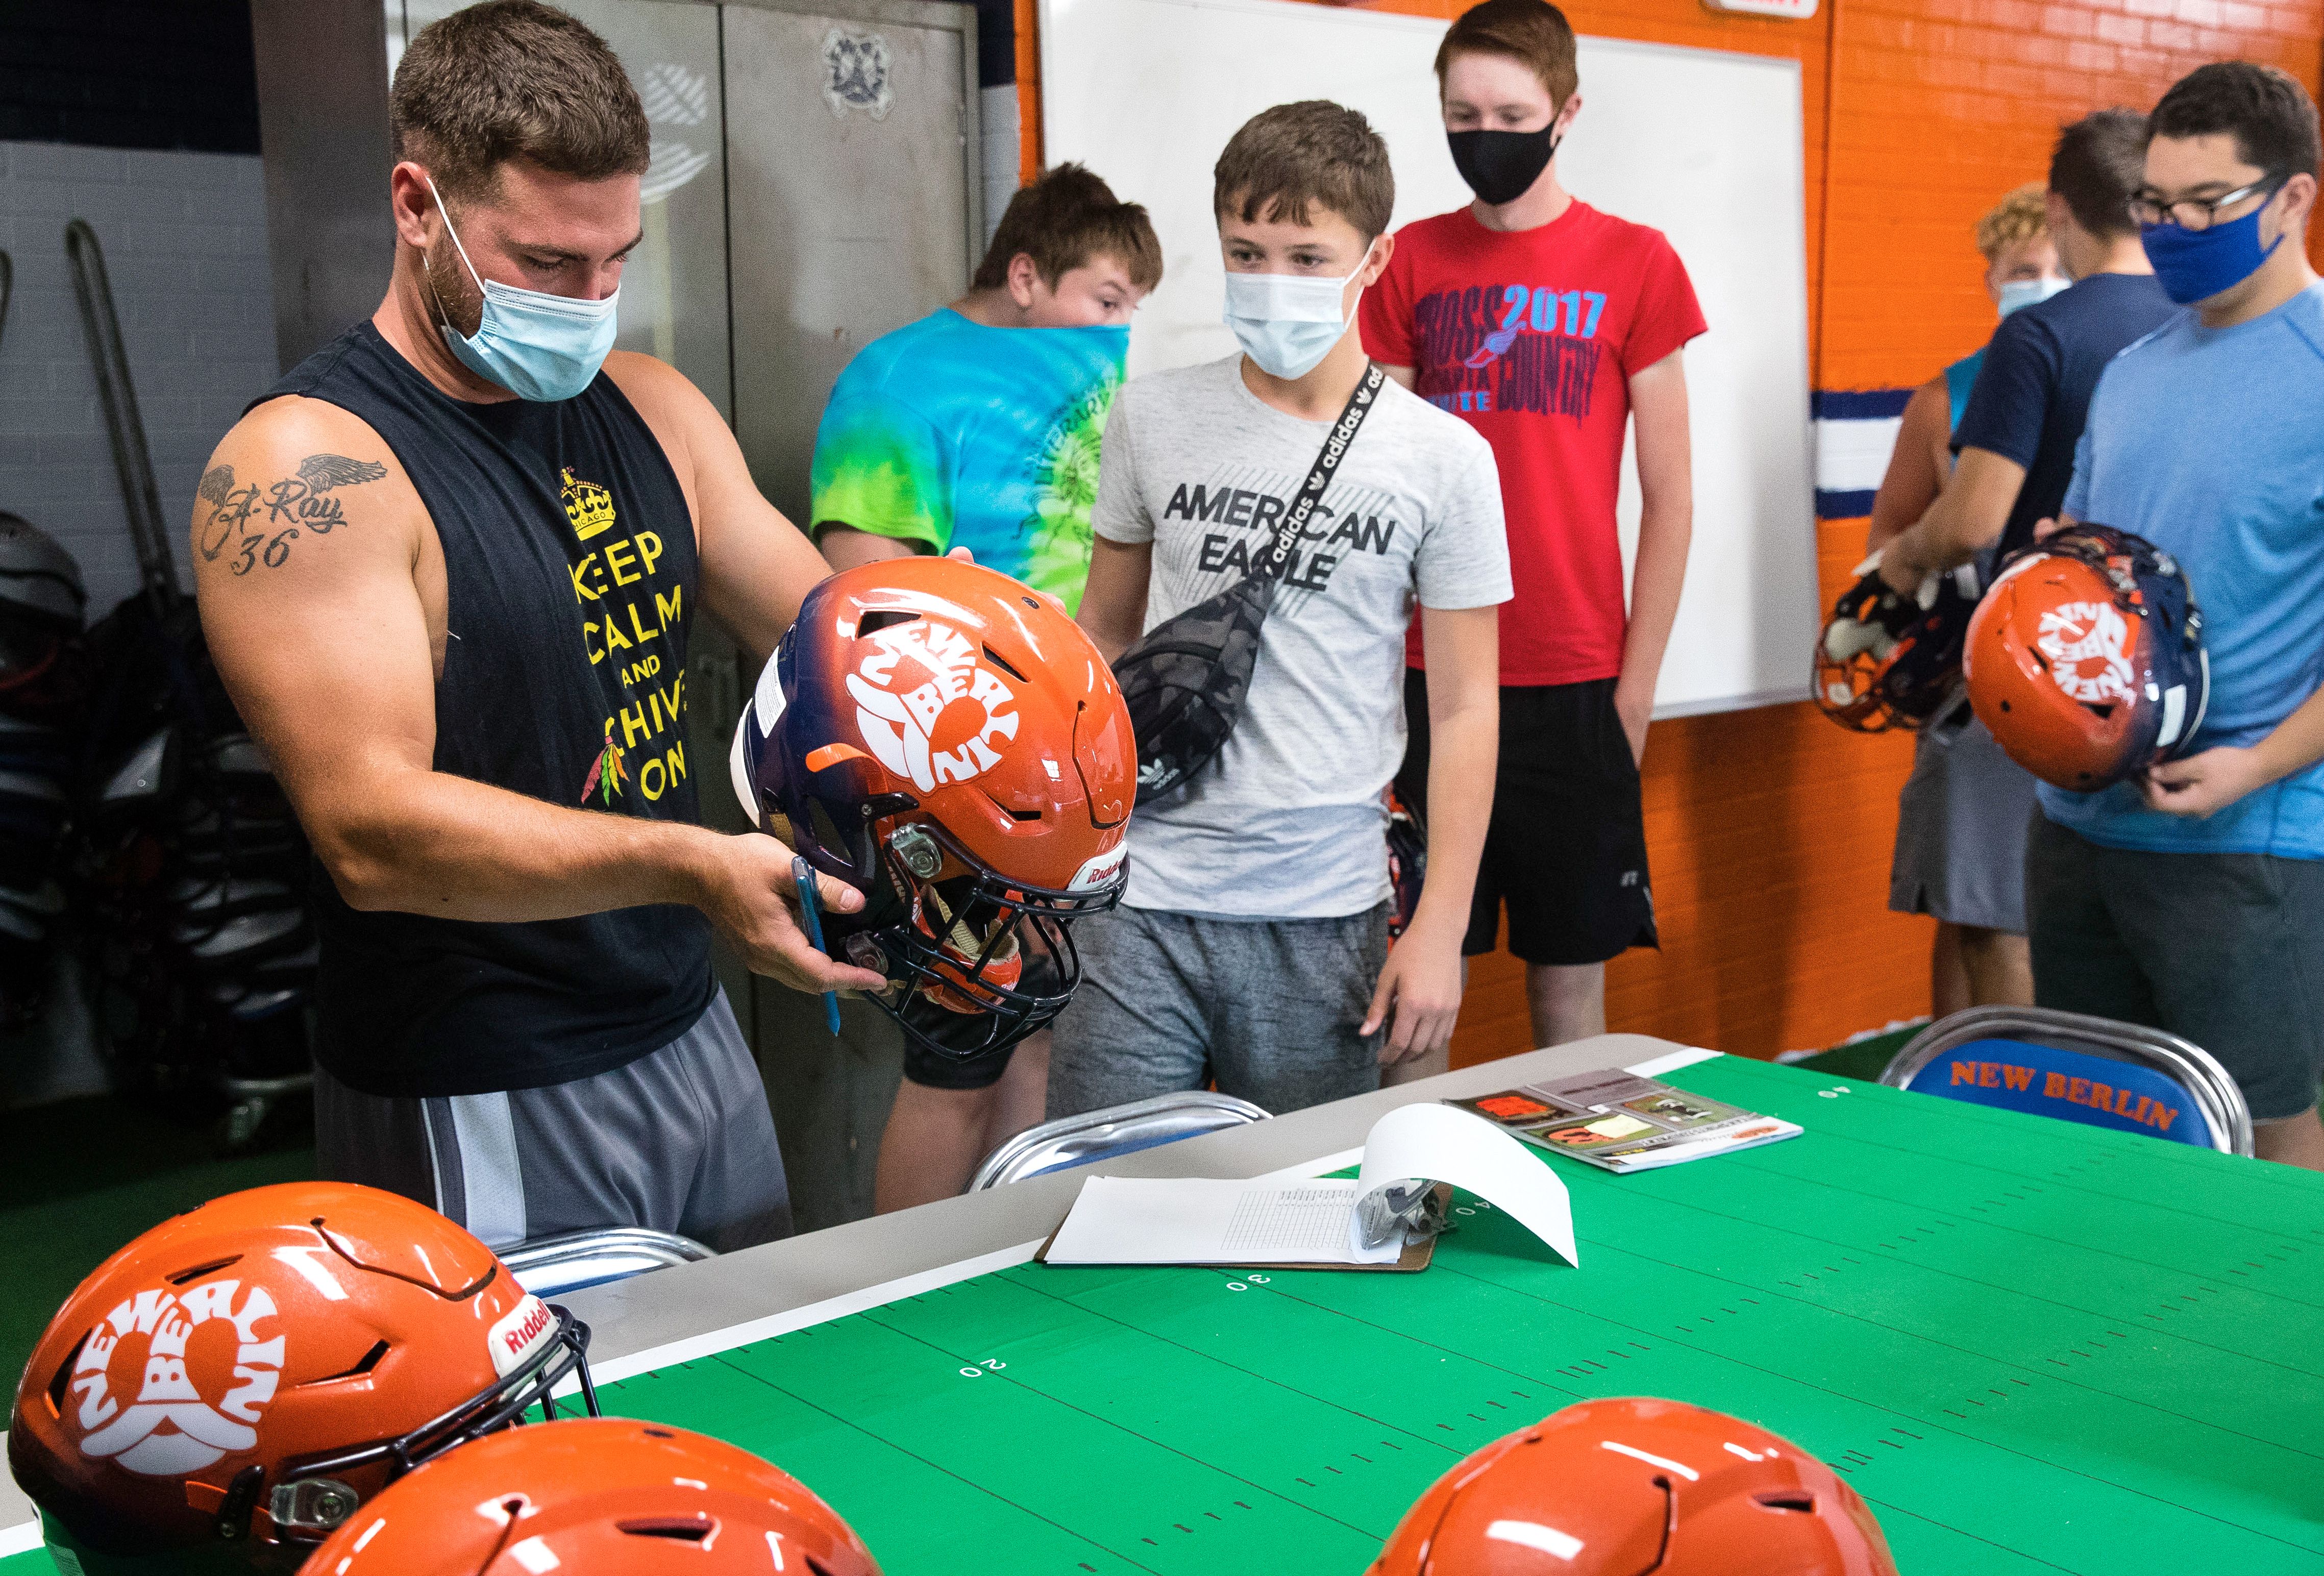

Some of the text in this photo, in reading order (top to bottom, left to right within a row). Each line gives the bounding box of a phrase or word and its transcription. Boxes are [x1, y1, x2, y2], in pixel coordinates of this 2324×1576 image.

[1503, 284, 1607, 339] 2017
[1323, 407, 1363, 469] adidas
[574, 511, 606, 530] HICAGO
[1164, 483, 1396, 556] AMERCAN
[1272, 496, 1314, 563] adidas
[231, 529, 300, 576] 36
[567, 530, 663, 604] KEEP
[583, 584, 682, 665] CALM
[621, 654, 660, 689] AND
[640, 740, 687, 801] ON
[1950, 1061, 2179, 1131] NEW BERLIN
[1226, 1274, 1271, 1292] 30
[72, 1279, 286, 1430] NEW BERLIN
[504, 1298, 551, 1355] Riddell
[959, 1358, 1007, 1377] 20
